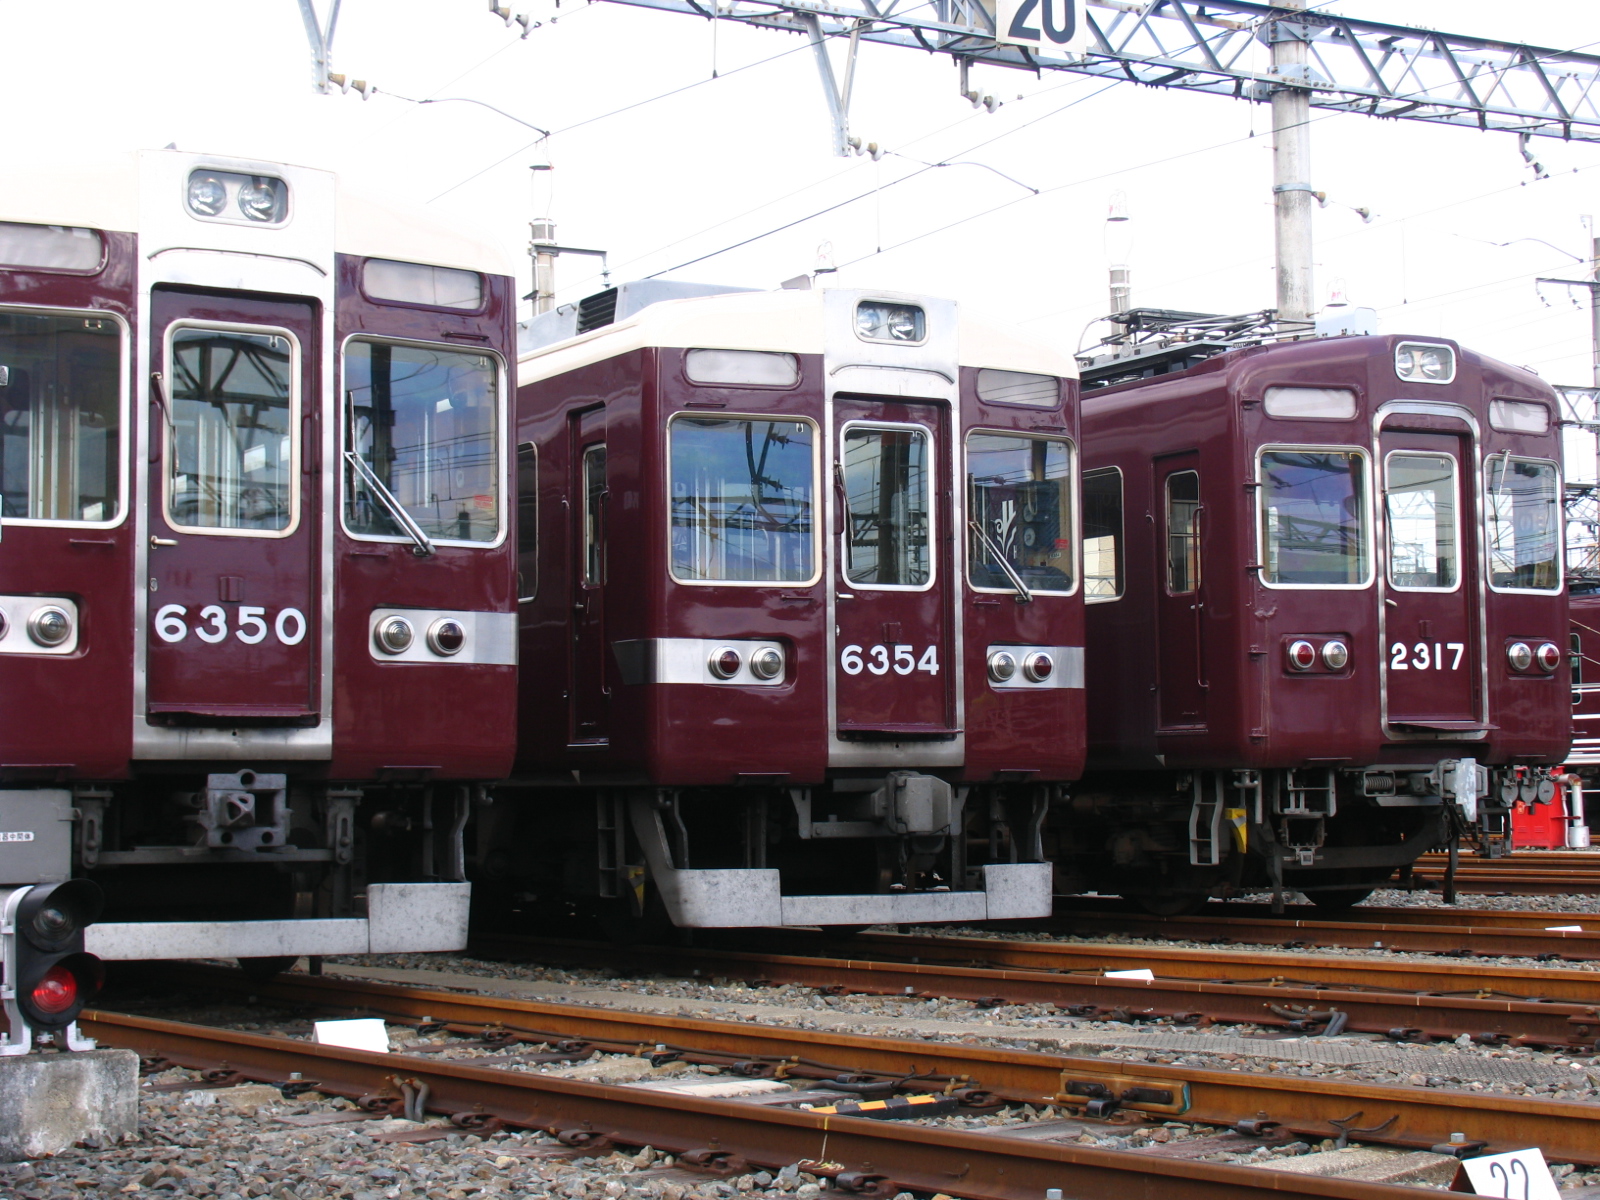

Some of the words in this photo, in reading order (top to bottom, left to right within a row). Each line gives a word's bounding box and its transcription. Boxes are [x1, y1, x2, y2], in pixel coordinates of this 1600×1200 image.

[1007, 0, 1076, 44] 20
[154, 603, 307, 646] 6350
[840, 644, 940, 676] 6354
[1390, 642, 1465, 671] 2317
